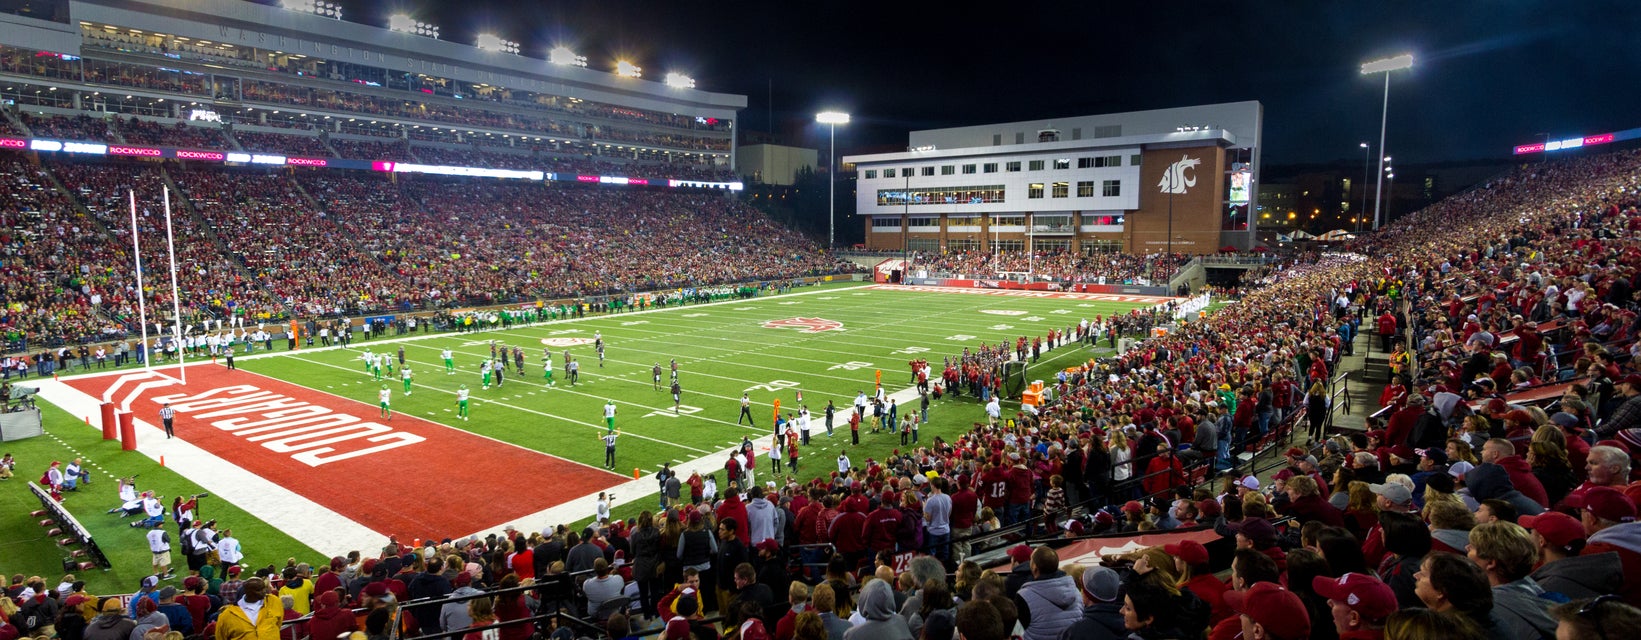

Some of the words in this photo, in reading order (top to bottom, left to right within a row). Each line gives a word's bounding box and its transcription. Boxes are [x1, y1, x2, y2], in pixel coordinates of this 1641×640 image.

[219, 25, 384, 63] WASHINGTON
[407, 57, 460, 75] STATE
[109, 146, 161, 156] ROCKWOOD
[176, 150, 223, 160] ROCKWOOD
[287, 157, 326, 166] ROCKWOOD
[743, 379, 801, 392] 20
[150, 383, 428, 468] COUGARS
[991, 481, 1006, 498] 12
[895, 552, 914, 574] 23
